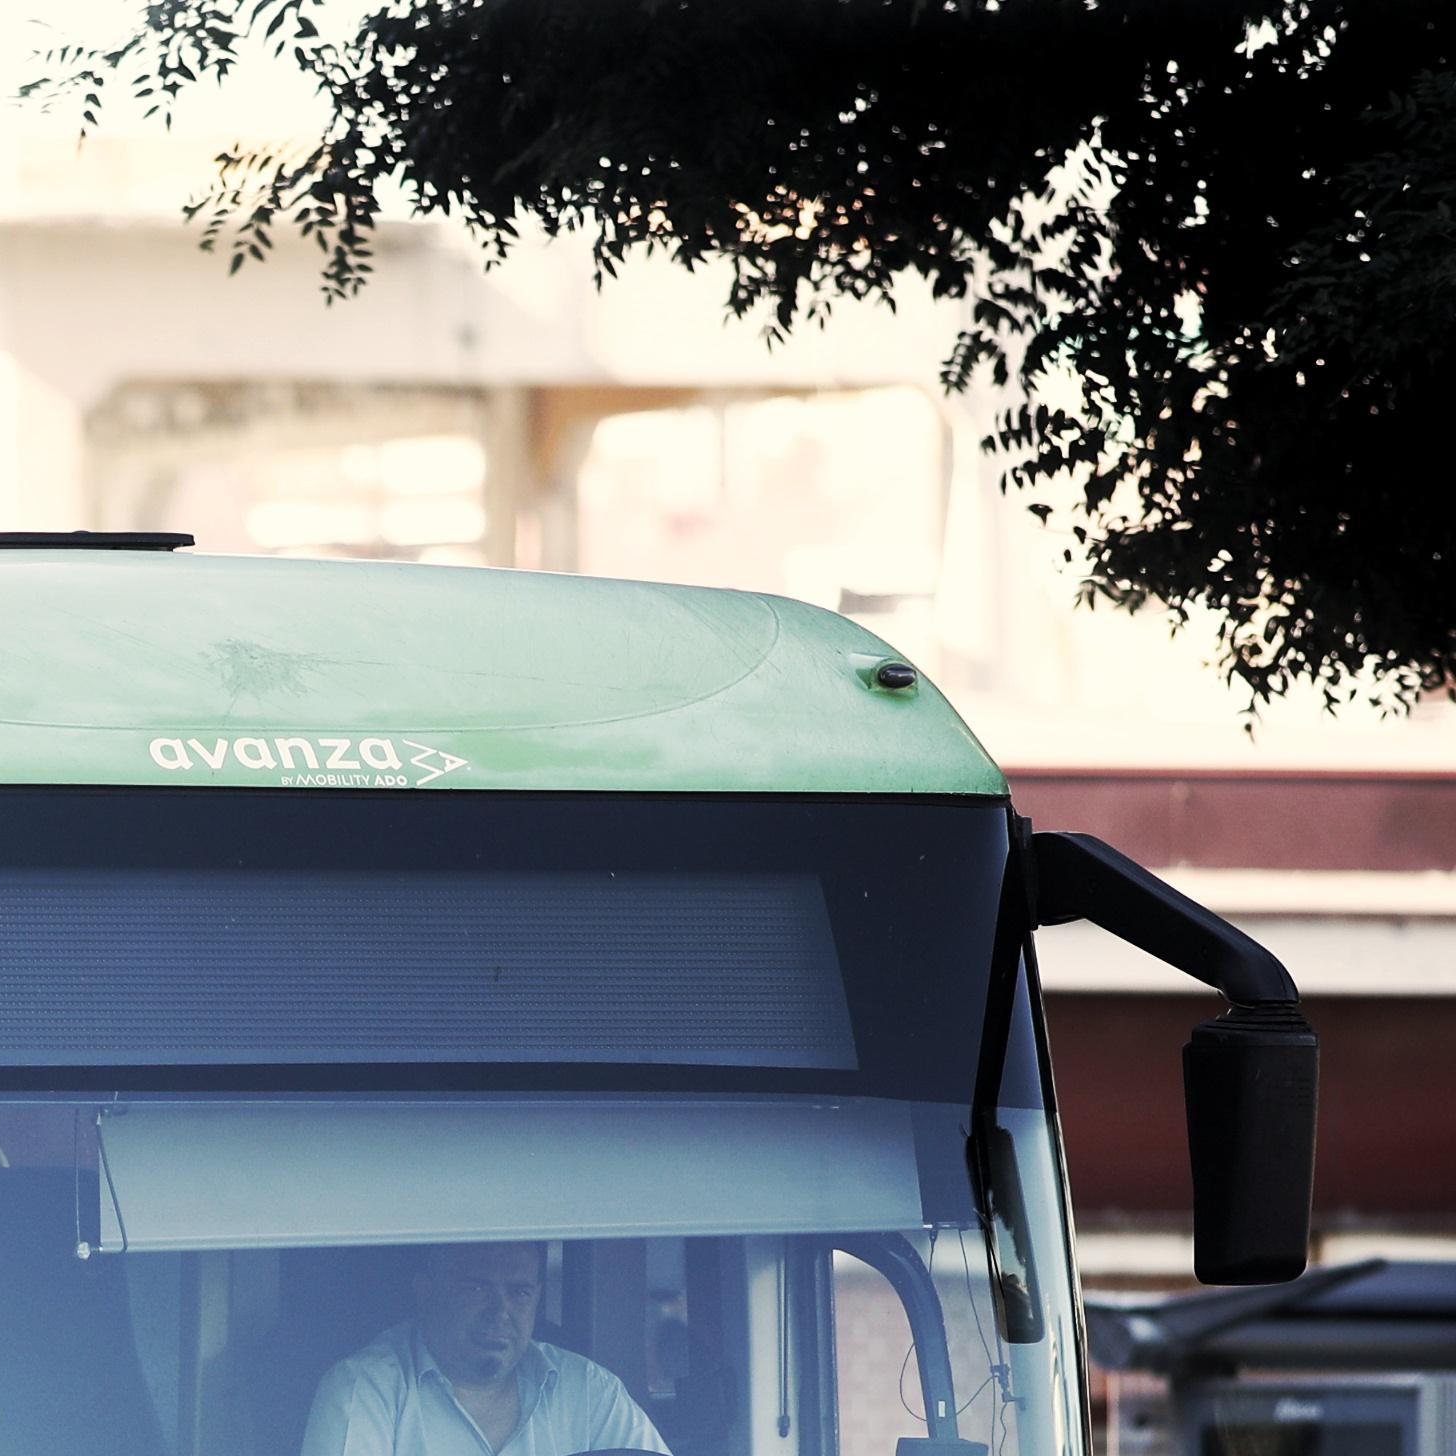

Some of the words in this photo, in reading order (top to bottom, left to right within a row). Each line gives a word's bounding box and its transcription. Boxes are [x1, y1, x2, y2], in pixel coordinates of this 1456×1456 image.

[149, 737, 403, 770] avanza
[281, 776, 295, 786] BY
[296, 773, 371, 786] MOBILITY
[374, 774, 408, 787] ADO
